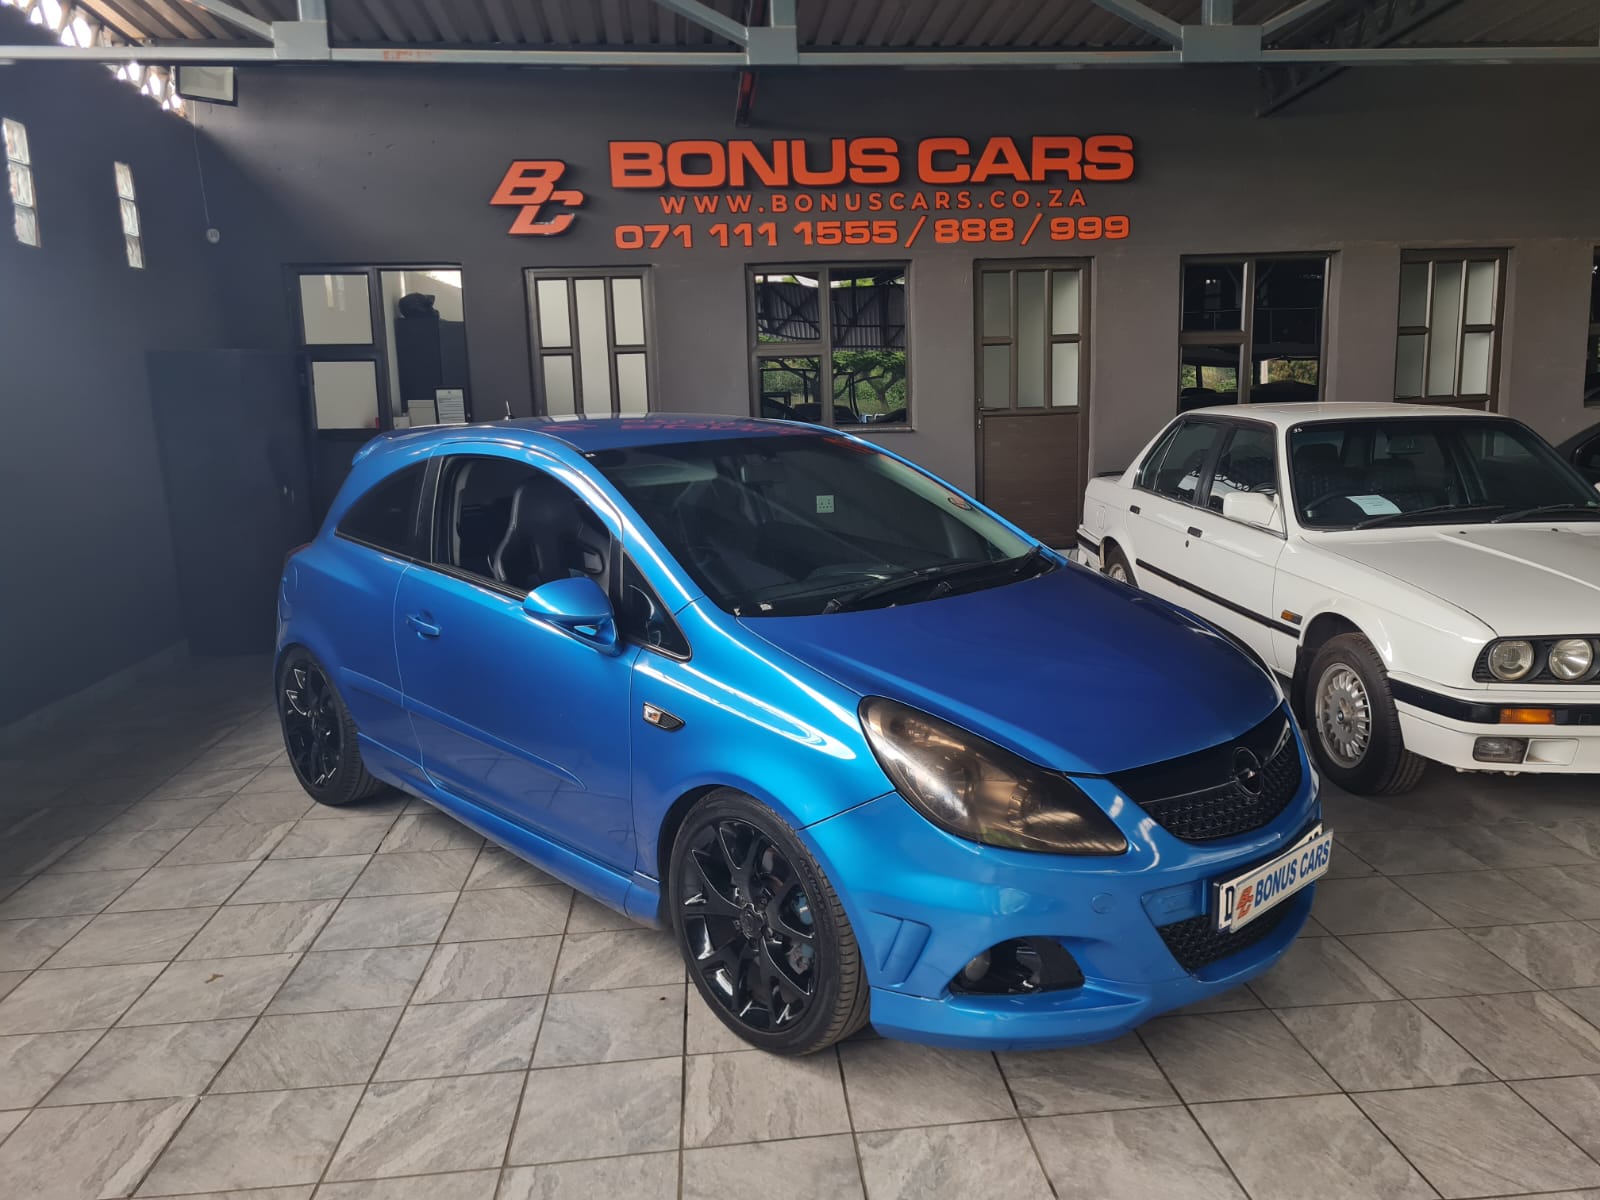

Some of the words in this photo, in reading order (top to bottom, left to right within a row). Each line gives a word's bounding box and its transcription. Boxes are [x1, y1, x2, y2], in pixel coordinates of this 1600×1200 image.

[609, 138, 900, 188] BONUS
[917, 135, 1134, 184] CARS
[490, 160, 584, 235] BC
[659, 189, 1086, 215] WWW.BONUSCARS.CO.ZA
[614, 223, 692, 250] 071
[708, 221, 777, 247] 111
[792, 219, 898, 246] 1555
[934, 217, 1014, 244] 888
[1050, 215, 1129, 241] 999
[1254, 859, 1298, 908] BONUS
[1299, 840, 1330, 878] CARS
